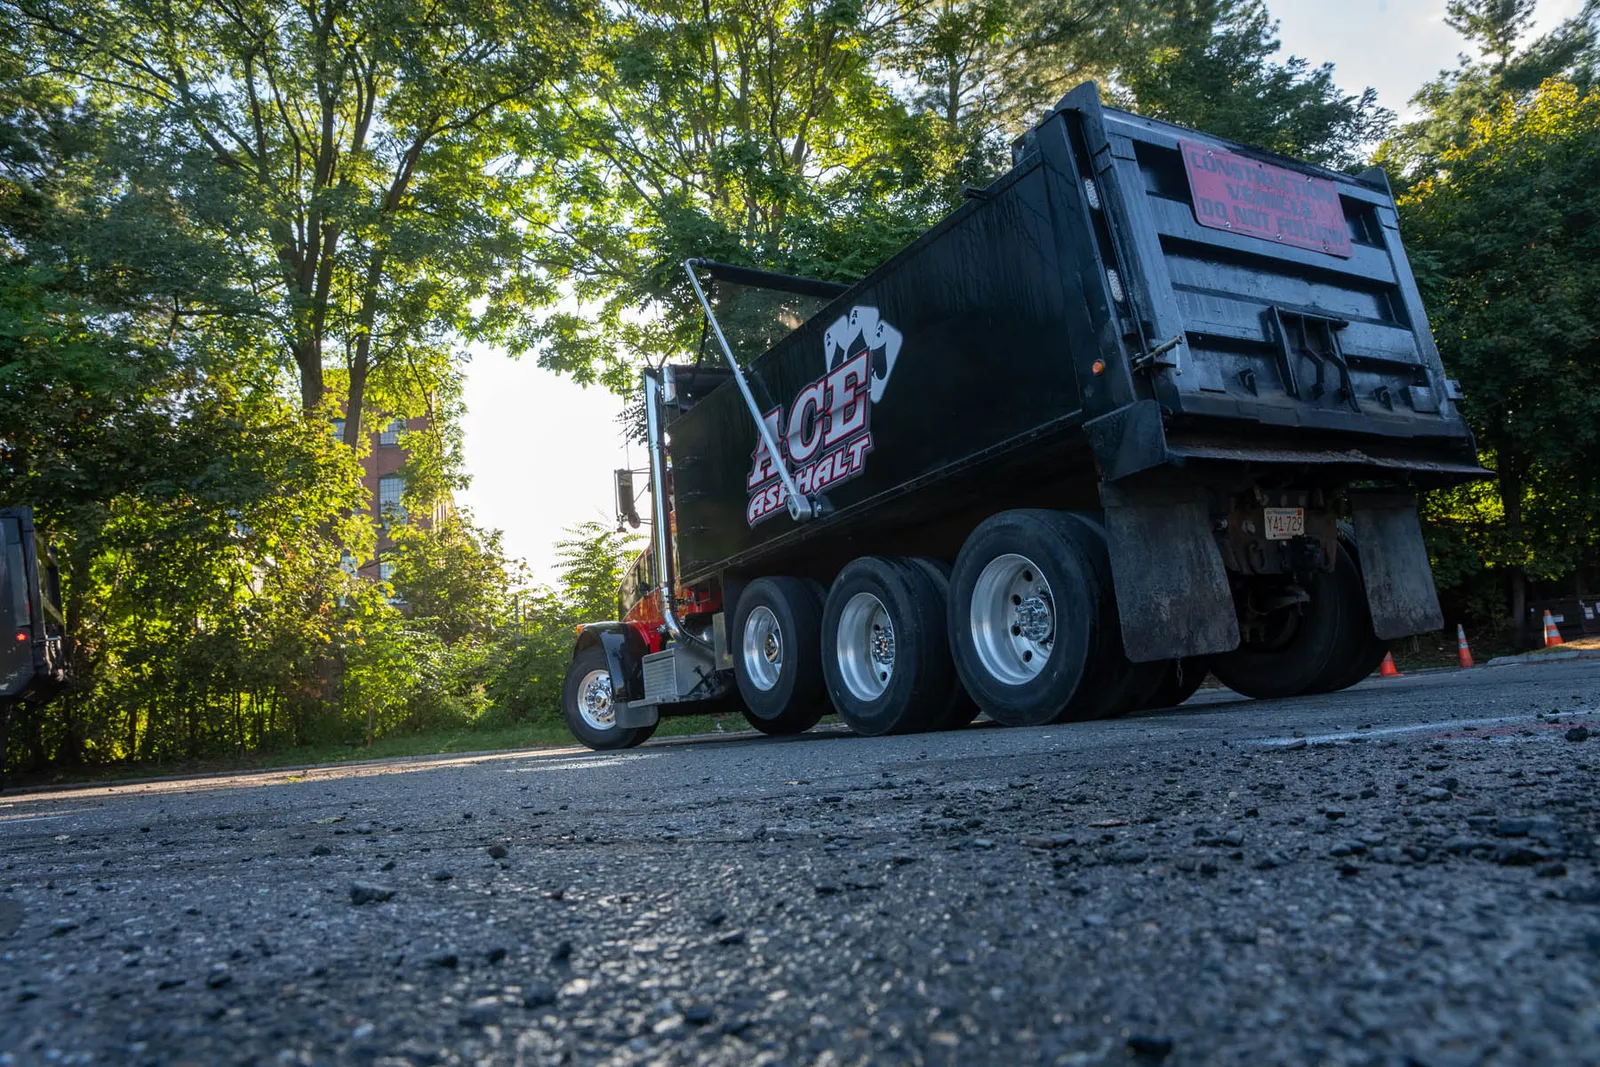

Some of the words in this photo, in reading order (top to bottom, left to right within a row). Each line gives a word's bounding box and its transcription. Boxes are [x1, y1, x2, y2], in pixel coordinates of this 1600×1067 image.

[1200, 197, 1228, 220] DO
[1232, 204, 1270, 231] NOT
[1275, 215, 1345, 247] FOLLOW
[1225, 181, 1317, 220] VEHICLE
[748, 350, 869, 488] ACE
